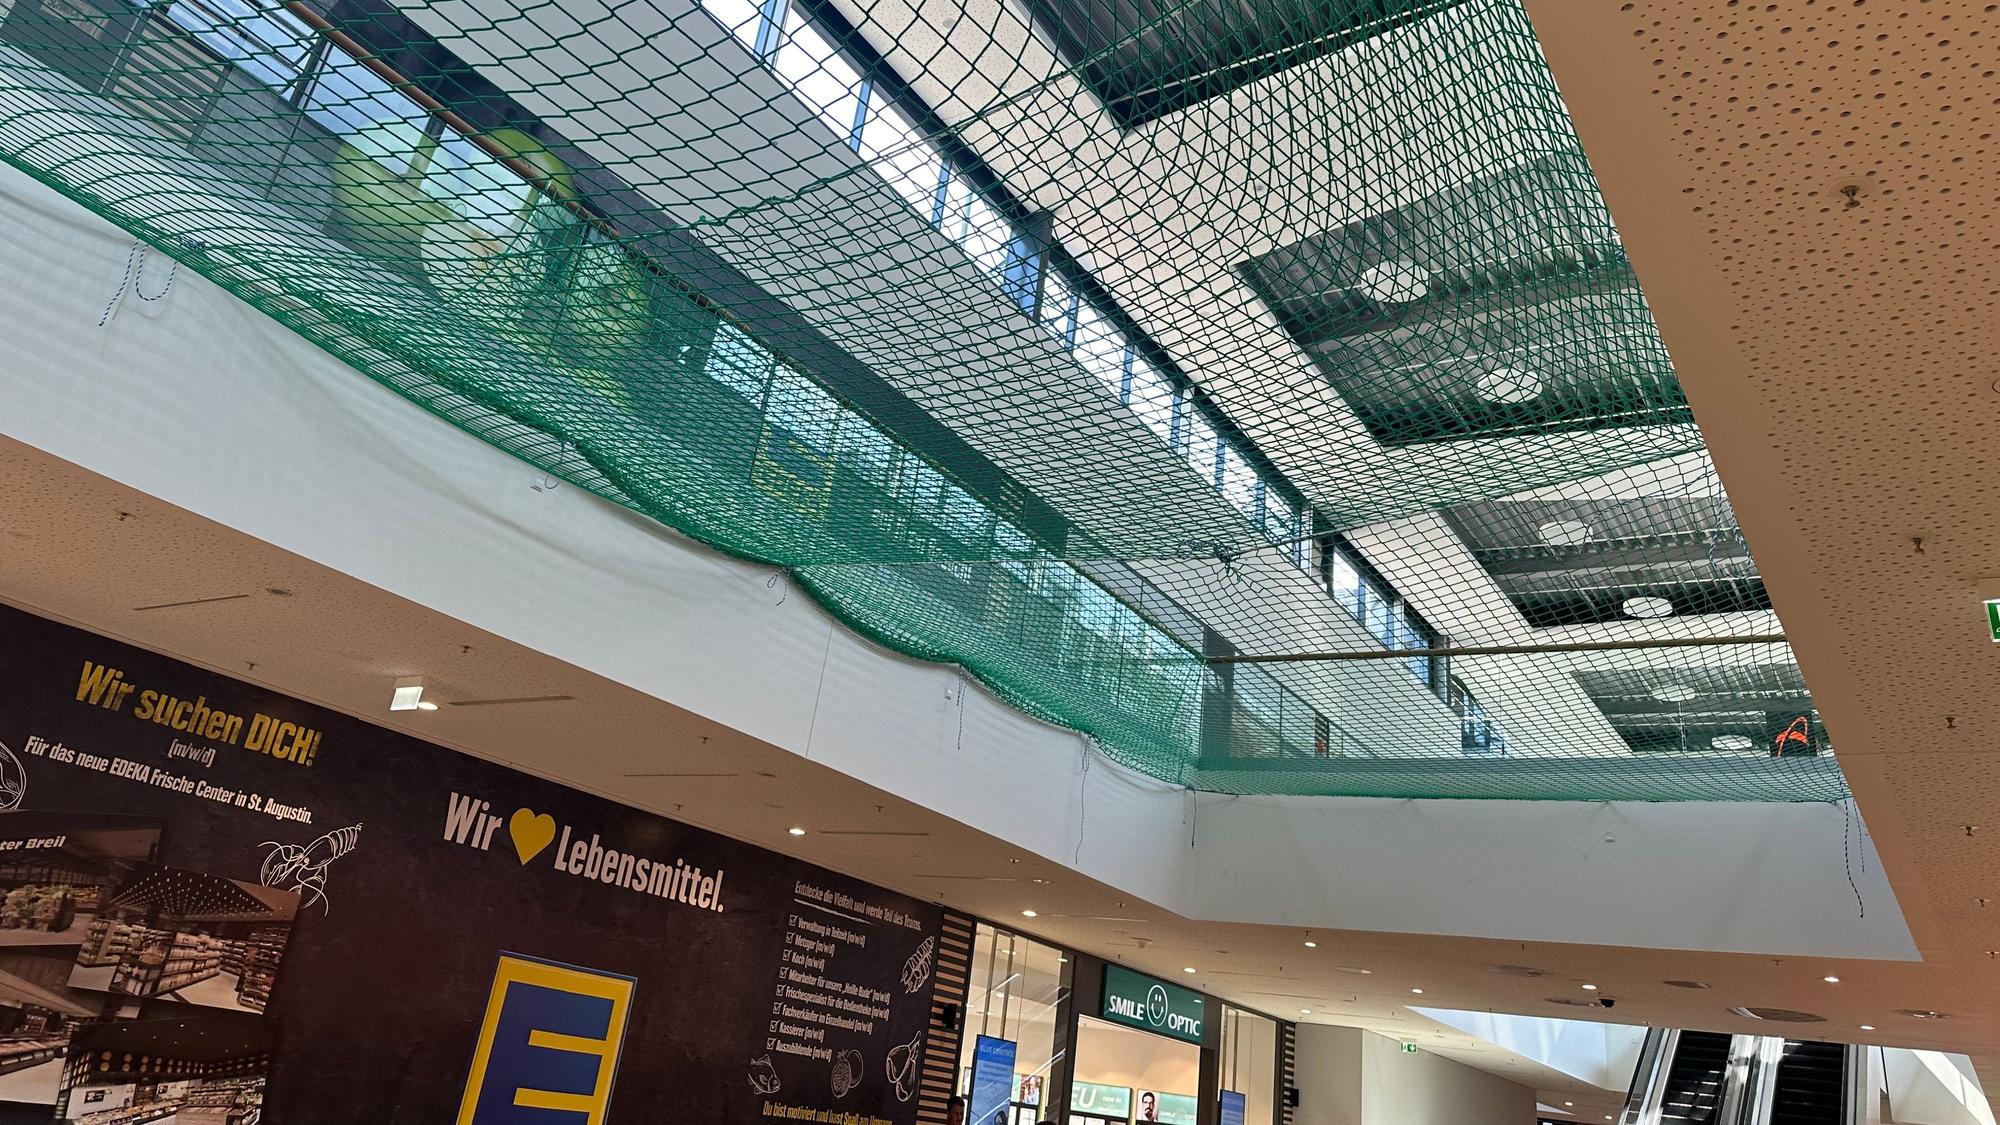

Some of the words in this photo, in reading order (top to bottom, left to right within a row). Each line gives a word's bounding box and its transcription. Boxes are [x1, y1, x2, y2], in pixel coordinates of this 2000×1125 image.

[76, 661, 135, 711] Wir
[134, 690, 243, 744] suchen
[244, 713, 322, 766] DICH!
[168, 739, 216, 768] (m/w/d)
[24, 735, 49, 756] Für
[49, 743, 75, 763] das
[75, 752, 109, 772] neue
[109, 757, 151, 783] EDEKA
[150, 768, 195, 794] Frische
[195, 780, 236, 804] Center
[235, 790, 248, 807] in
[248, 793, 262, 811] St.
[263, 798, 312, 824] Augustin.
[25, 835, 66, 849] Breil
[443, 791, 503, 851] Wir
[554, 825, 724, 913] Lebensmittel.
[853, 901, 866, 913] und
[865, 904, 883, 919] werde
[1108, 994, 1145, 1020] SMILE
[1168, 1012, 1201, 1036] OPTIC
[762, 1100, 773, 1116] Du
[773, 1102, 787, 1118] bist
[787, 1105, 816, 1121] motiviert
[816, 1109, 829, 1123] und
